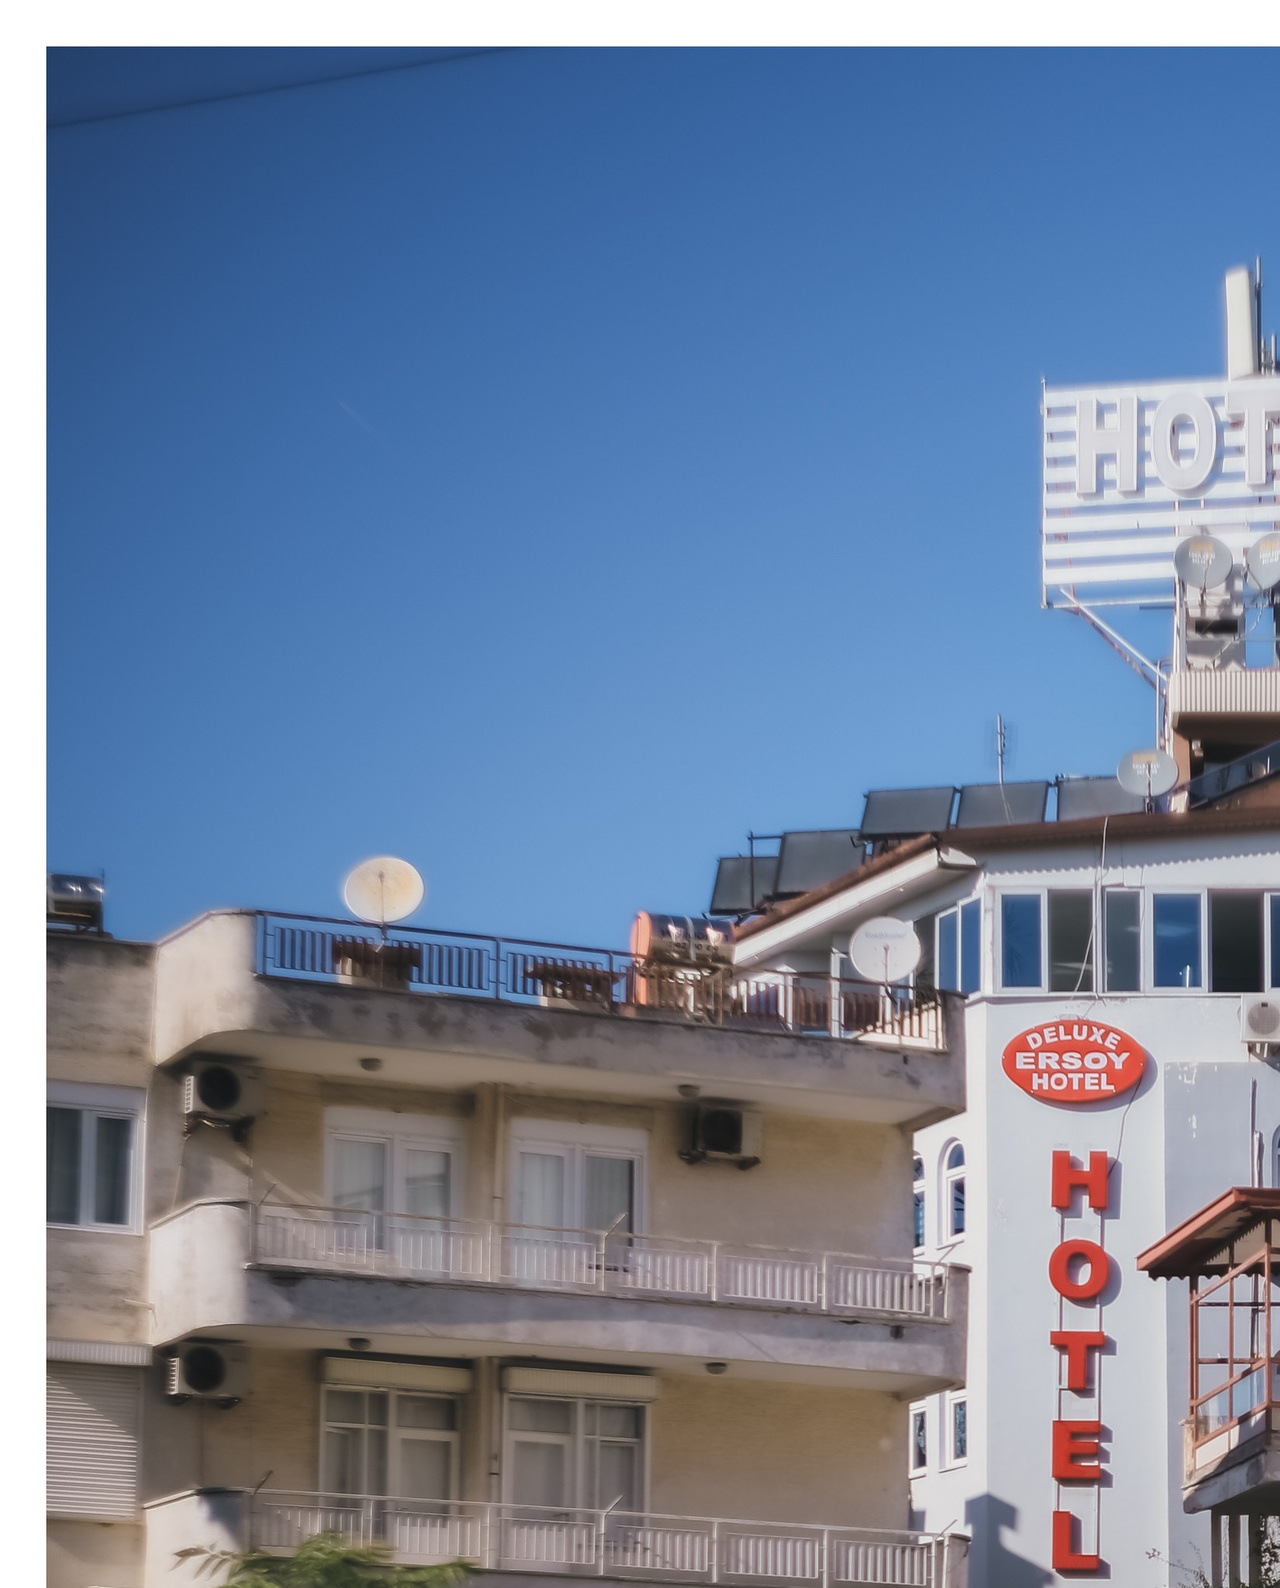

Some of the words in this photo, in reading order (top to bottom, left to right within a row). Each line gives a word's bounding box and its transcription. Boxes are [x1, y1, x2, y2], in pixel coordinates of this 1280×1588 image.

[1026, 1024, 1122, 1050] DELUXE
[1015, 1052, 1130, 1070] ERSOY
[1032, 1072, 1115, 1091] HOTEL
[1048, 1150, 1111, 1570] HOTEL
